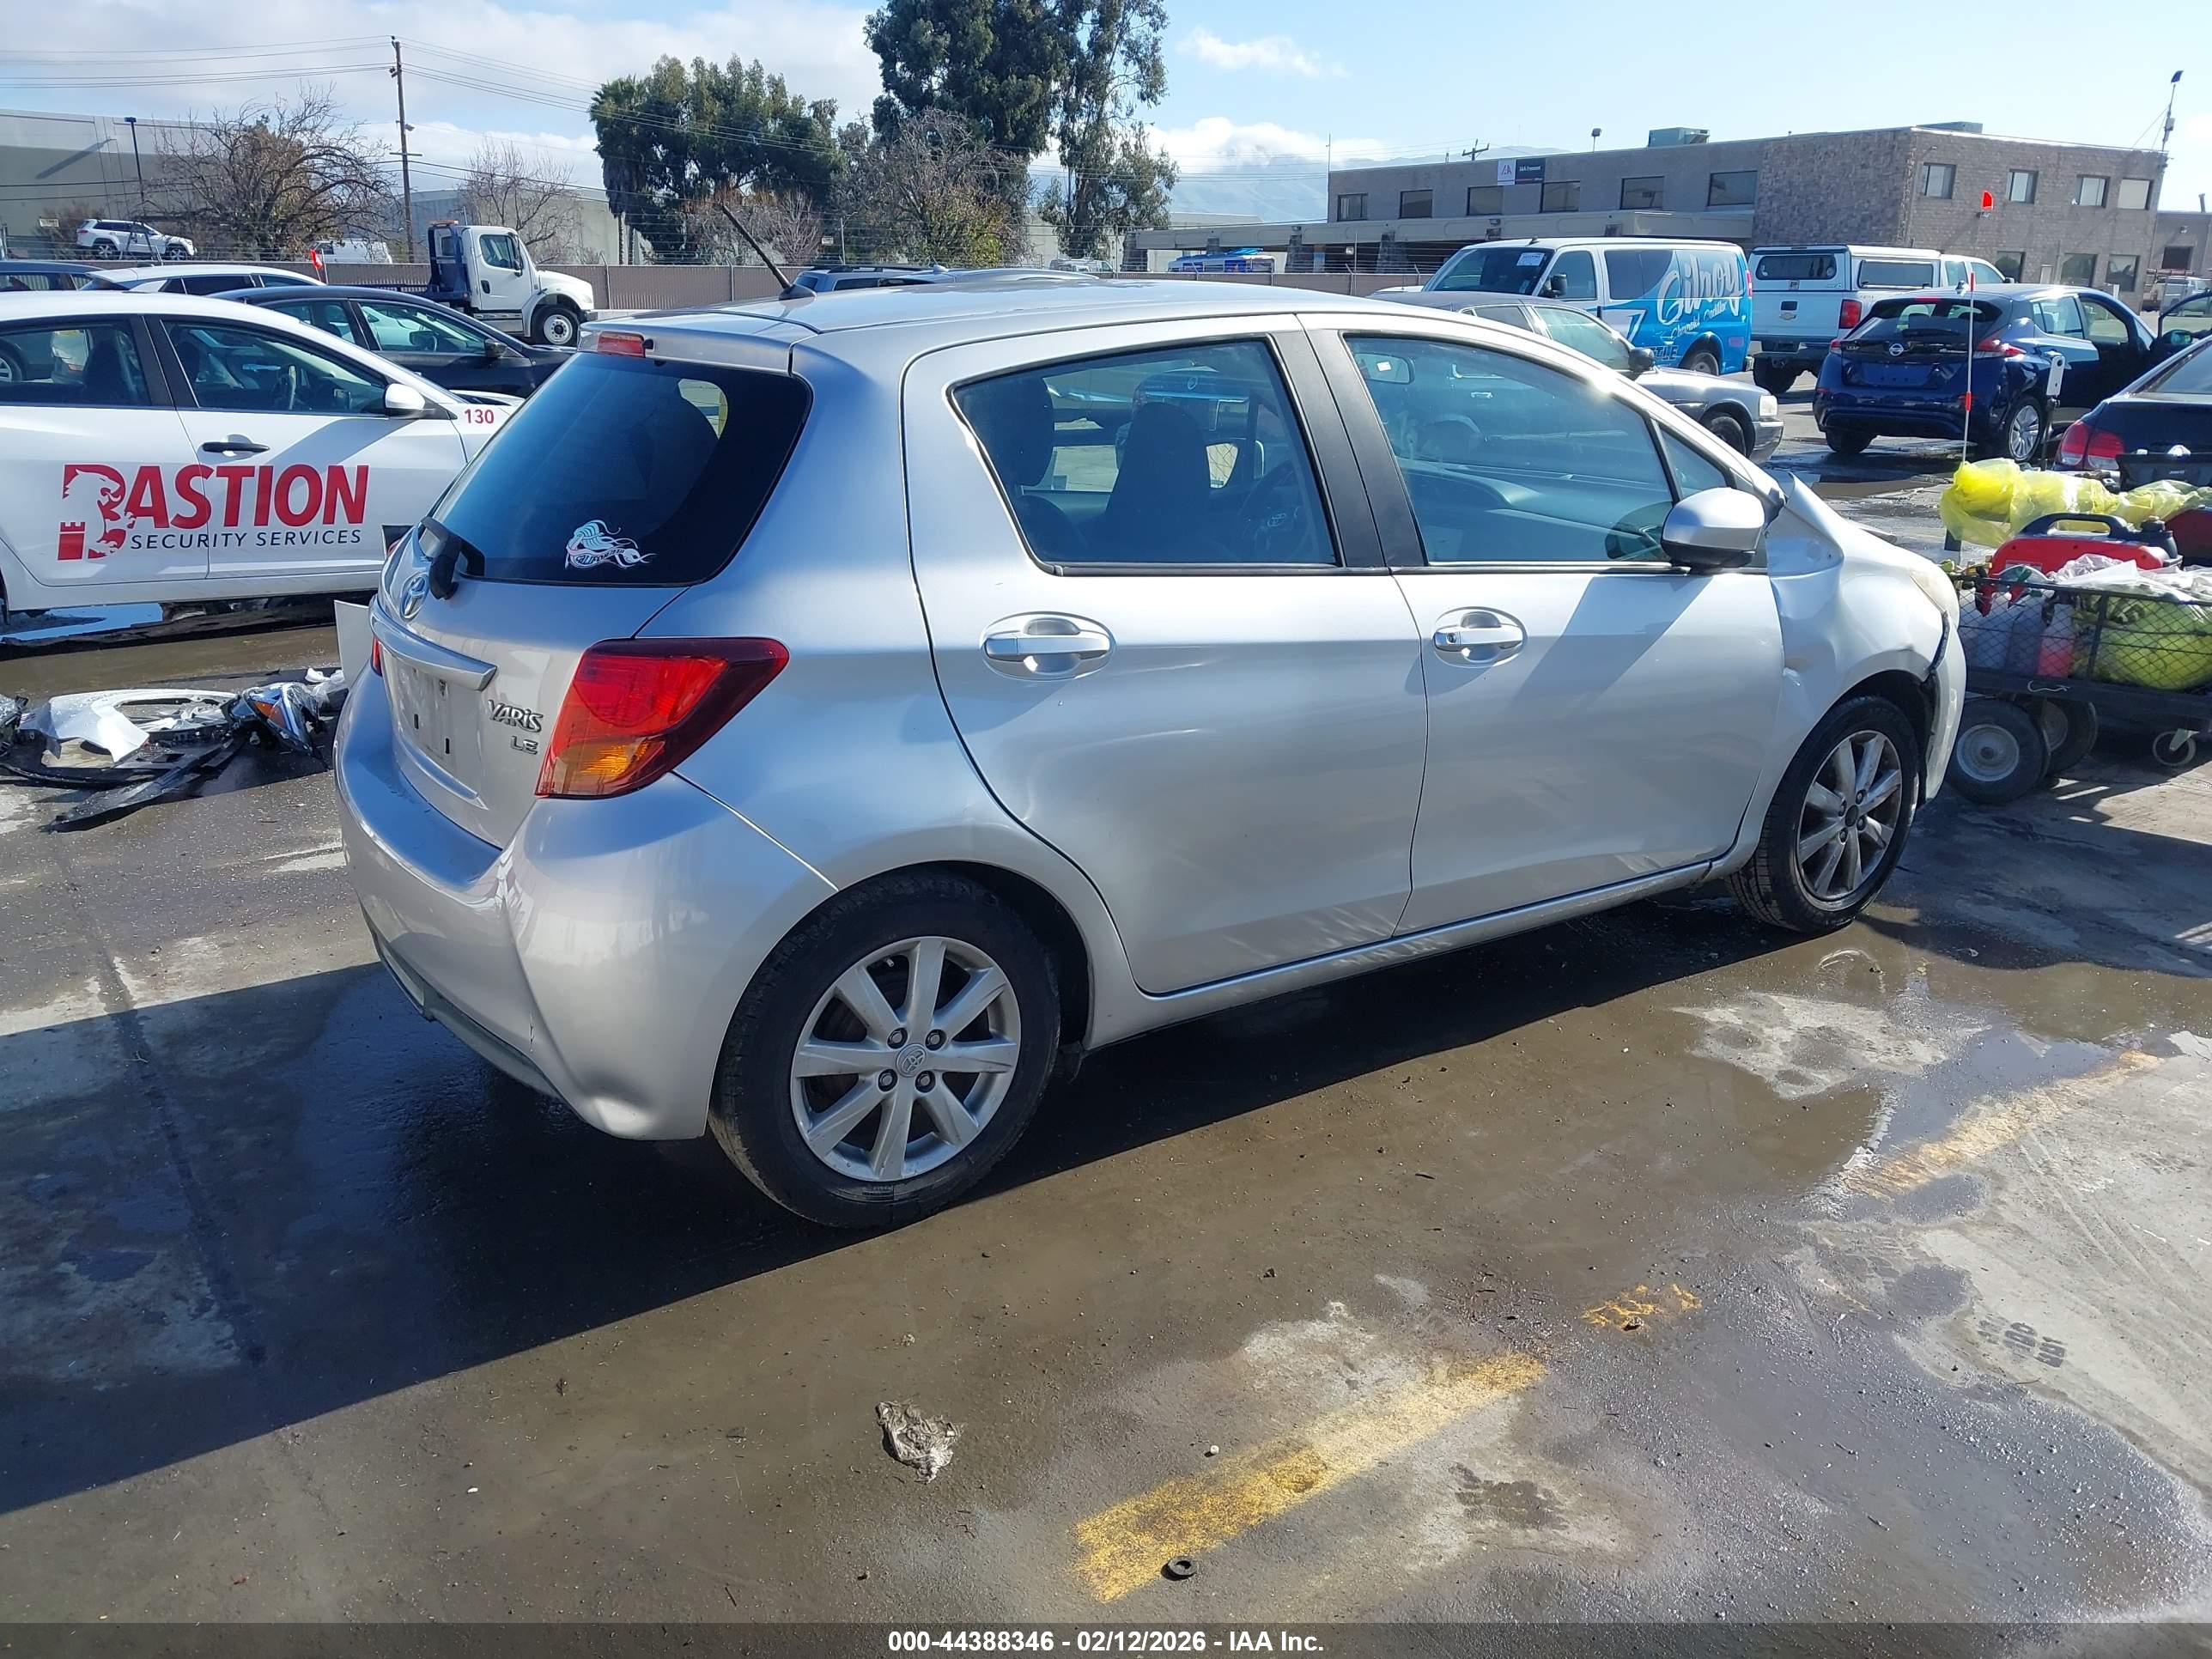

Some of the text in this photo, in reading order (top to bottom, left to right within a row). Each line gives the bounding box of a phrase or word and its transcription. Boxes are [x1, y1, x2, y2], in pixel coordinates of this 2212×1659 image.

[1657, 254, 1744, 325] Gilroy
[465, 409, 494, 423] 130
[58, 464, 369, 561] BASTION
[131, 529, 362, 550] SECURITY SERVICES
[510, 735, 538, 755] LE
